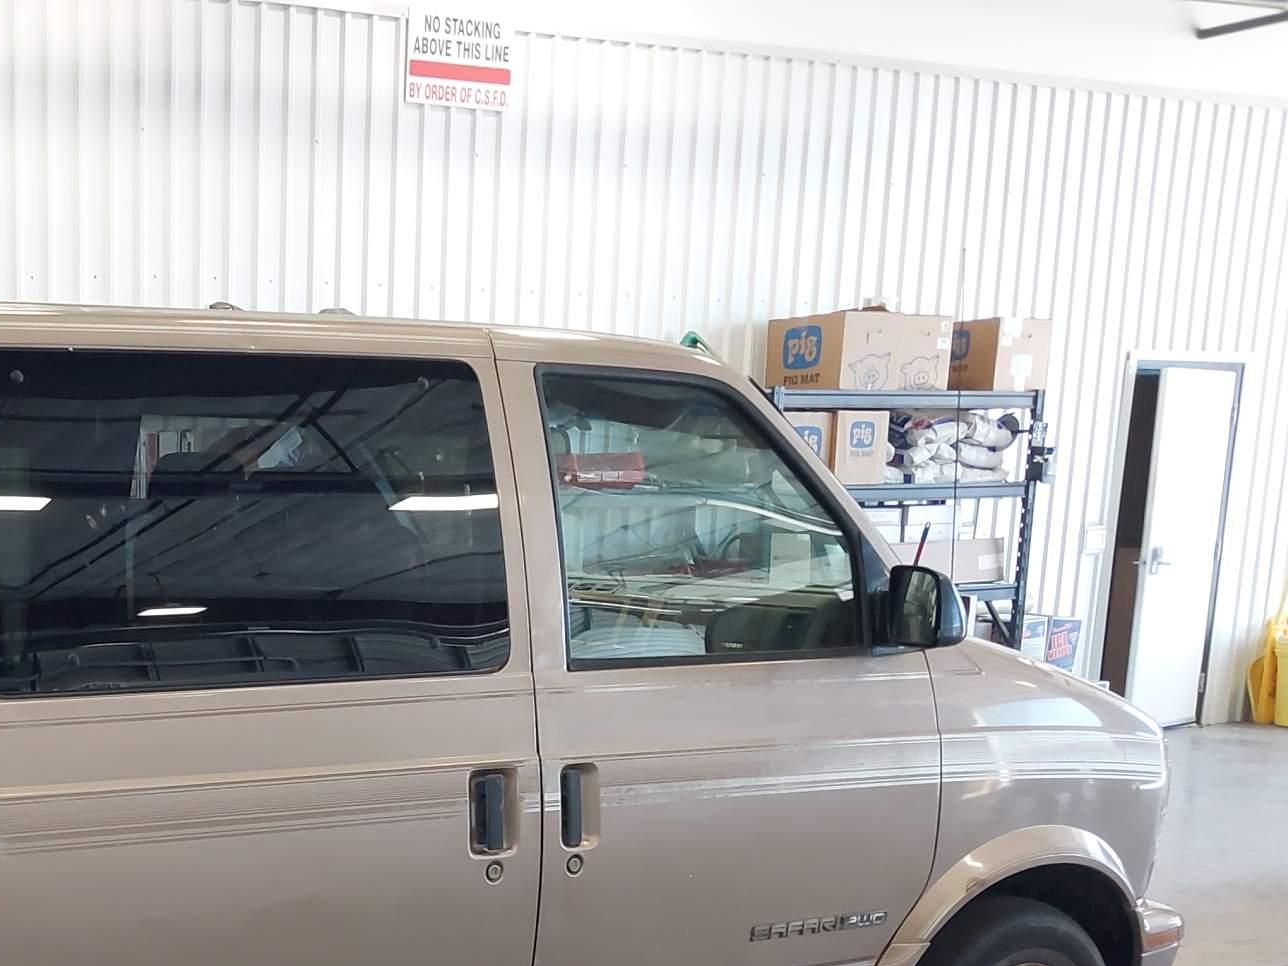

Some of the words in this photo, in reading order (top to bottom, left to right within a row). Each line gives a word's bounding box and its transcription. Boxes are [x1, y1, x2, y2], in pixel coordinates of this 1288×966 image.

[424, 14, 441, 33] NO
[444, 17, 501, 39] STACKING
[413, 36, 452, 57] ABOVE
[456, 41, 481, 60] THIS
[485, 44, 510, 63] LINE
[409, 82, 422, 99] BY
[424, 84, 457, 102] ORDER
[460, 87, 473, 103] OF
[787, 331, 818, 365] pig
[800, 373, 820, 385] MAT
[853, 423, 872, 445] pig
